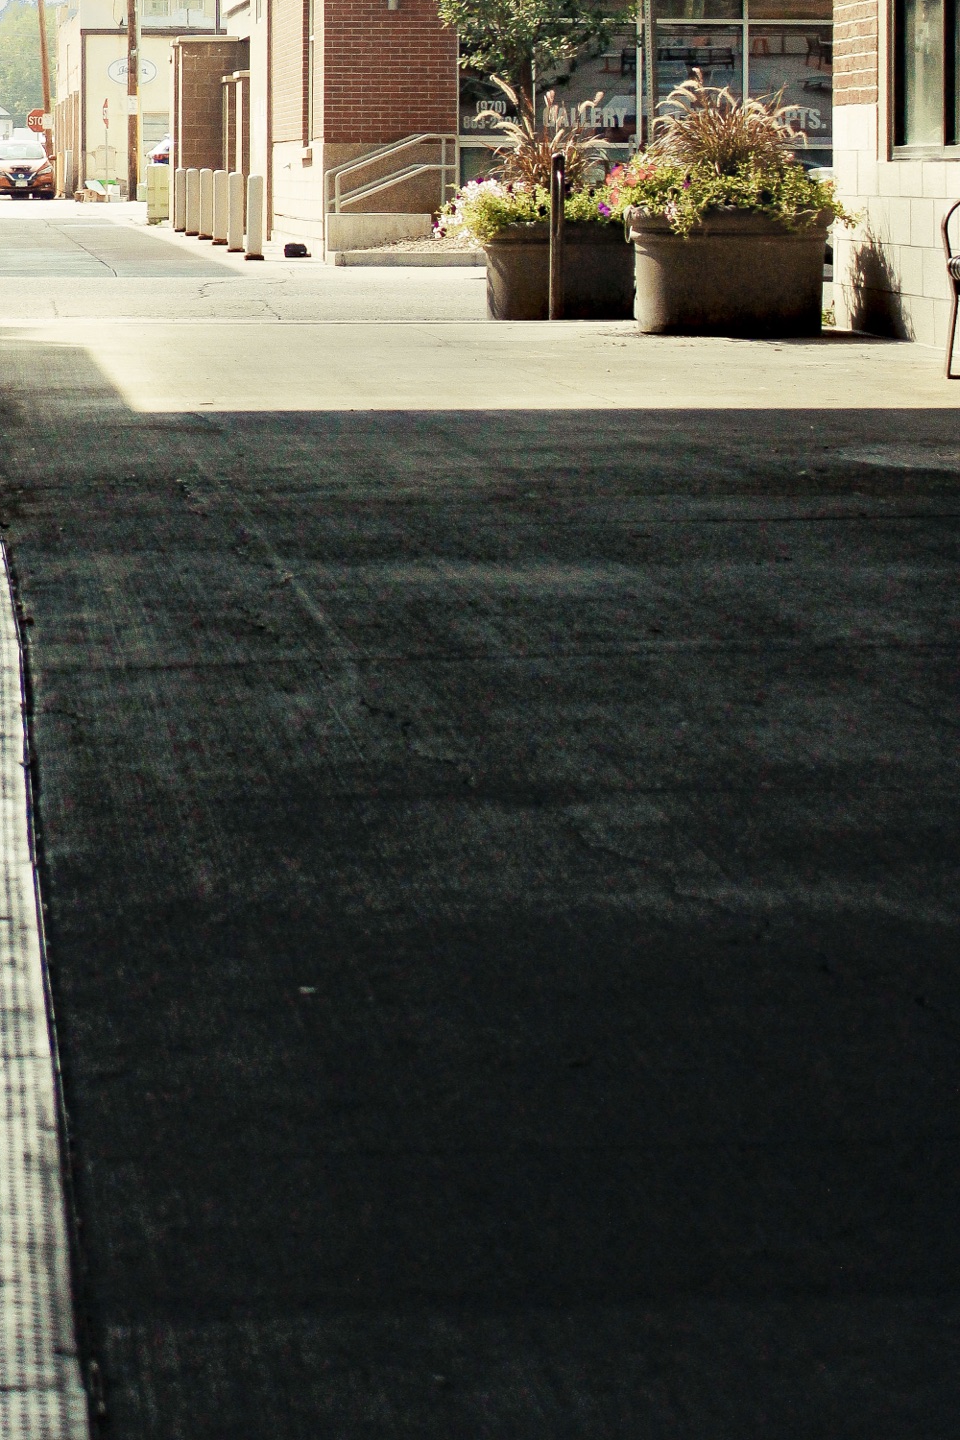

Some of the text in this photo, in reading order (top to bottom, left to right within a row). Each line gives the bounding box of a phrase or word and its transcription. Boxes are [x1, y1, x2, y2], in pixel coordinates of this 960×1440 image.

[475, 100, 507, 115] (970)
[28, 116, 44, 126] STO
[543, 107, 627, 128] GALLERY
